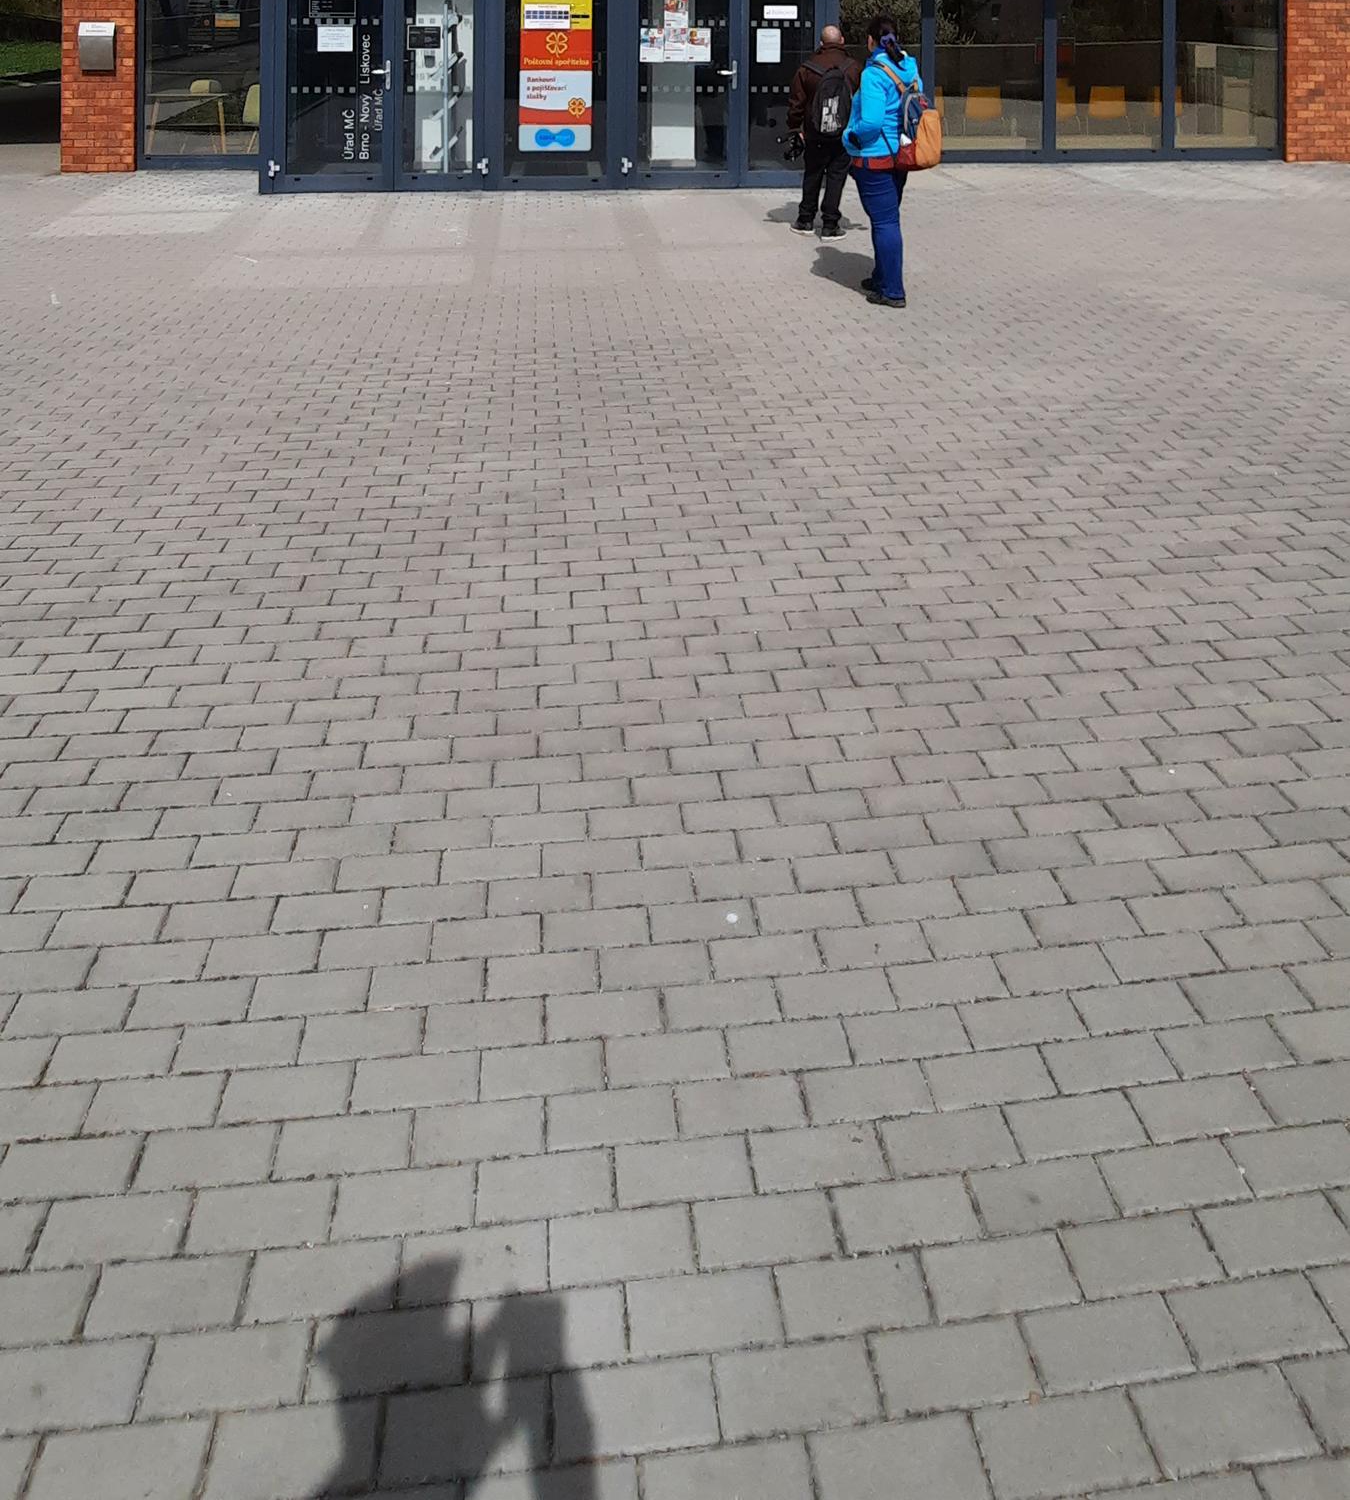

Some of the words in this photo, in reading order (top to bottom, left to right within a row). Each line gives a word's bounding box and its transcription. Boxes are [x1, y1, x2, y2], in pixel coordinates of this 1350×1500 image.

[523, 57, 553, 66] Poštovní
[341, 108, 355, 129] MČ
[359, 93, 372, 123] Nový
[341, 133, 355, 160] Úřad
[359, 133, 370, 160] Brno
